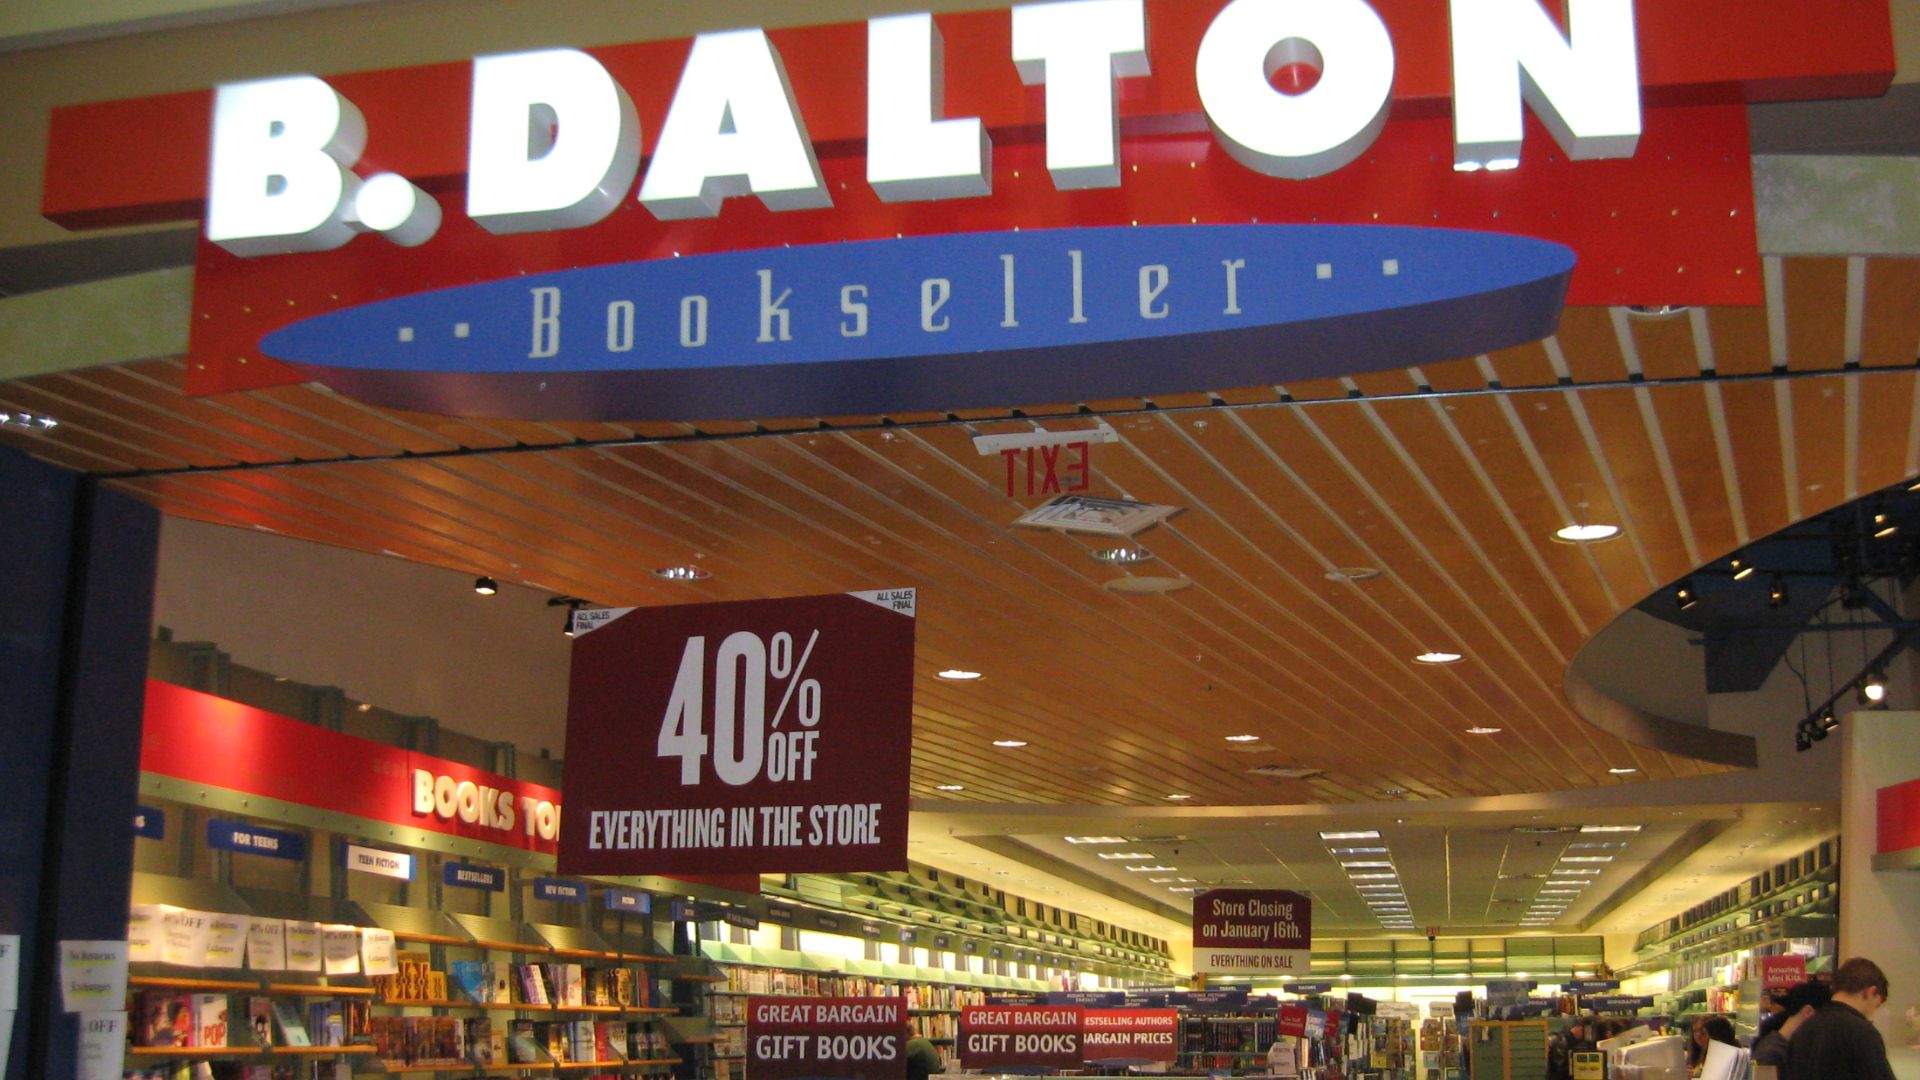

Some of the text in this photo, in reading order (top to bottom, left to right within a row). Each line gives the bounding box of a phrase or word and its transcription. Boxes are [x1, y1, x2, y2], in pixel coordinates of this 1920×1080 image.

[206, 0, 1642, 246] B. DALTON
[528, 250, 1246, 359] Bookseller
[876, 590, 913, 600] ALL SALES
[892, 600, 912, 609] FINAL
[590, 610, 611, 619] SALES
[657, 629, 822, 786] 40%
[767, 730, 820, 782] OFF
[414, 768, 516, 831] BOOKS
[589, 803, 882, 850] EVERYTHING IN THE STORE
[233, 832, 279, 850] FOR TEENS
[358, 854, 400, 870] TEEN FICTION
[457, 869, 494, 885] BESTSELLERS
[1212, 899, 1294, 921] Store Closing
[1203, 920, 1302, 942] on January 16th.
[1211, 954, 1293, 969] EVERYTHING ON SALE
[757, 1004, 898, 1023] GREAT BARGAIN
[968, 1011, 1077, 1026] GREAT BARGAIN
[1084, 1016, 1173, 1026] ESTSELLING AUTHORS
[204, 1024, 226, 1046] POP
[968, 1034, 1077, 1054] GIFT BOOKS
[1133, 1032, 1173, 1045] PRICES
[756, 1035, 897, 1060] GIFT BOOKS
